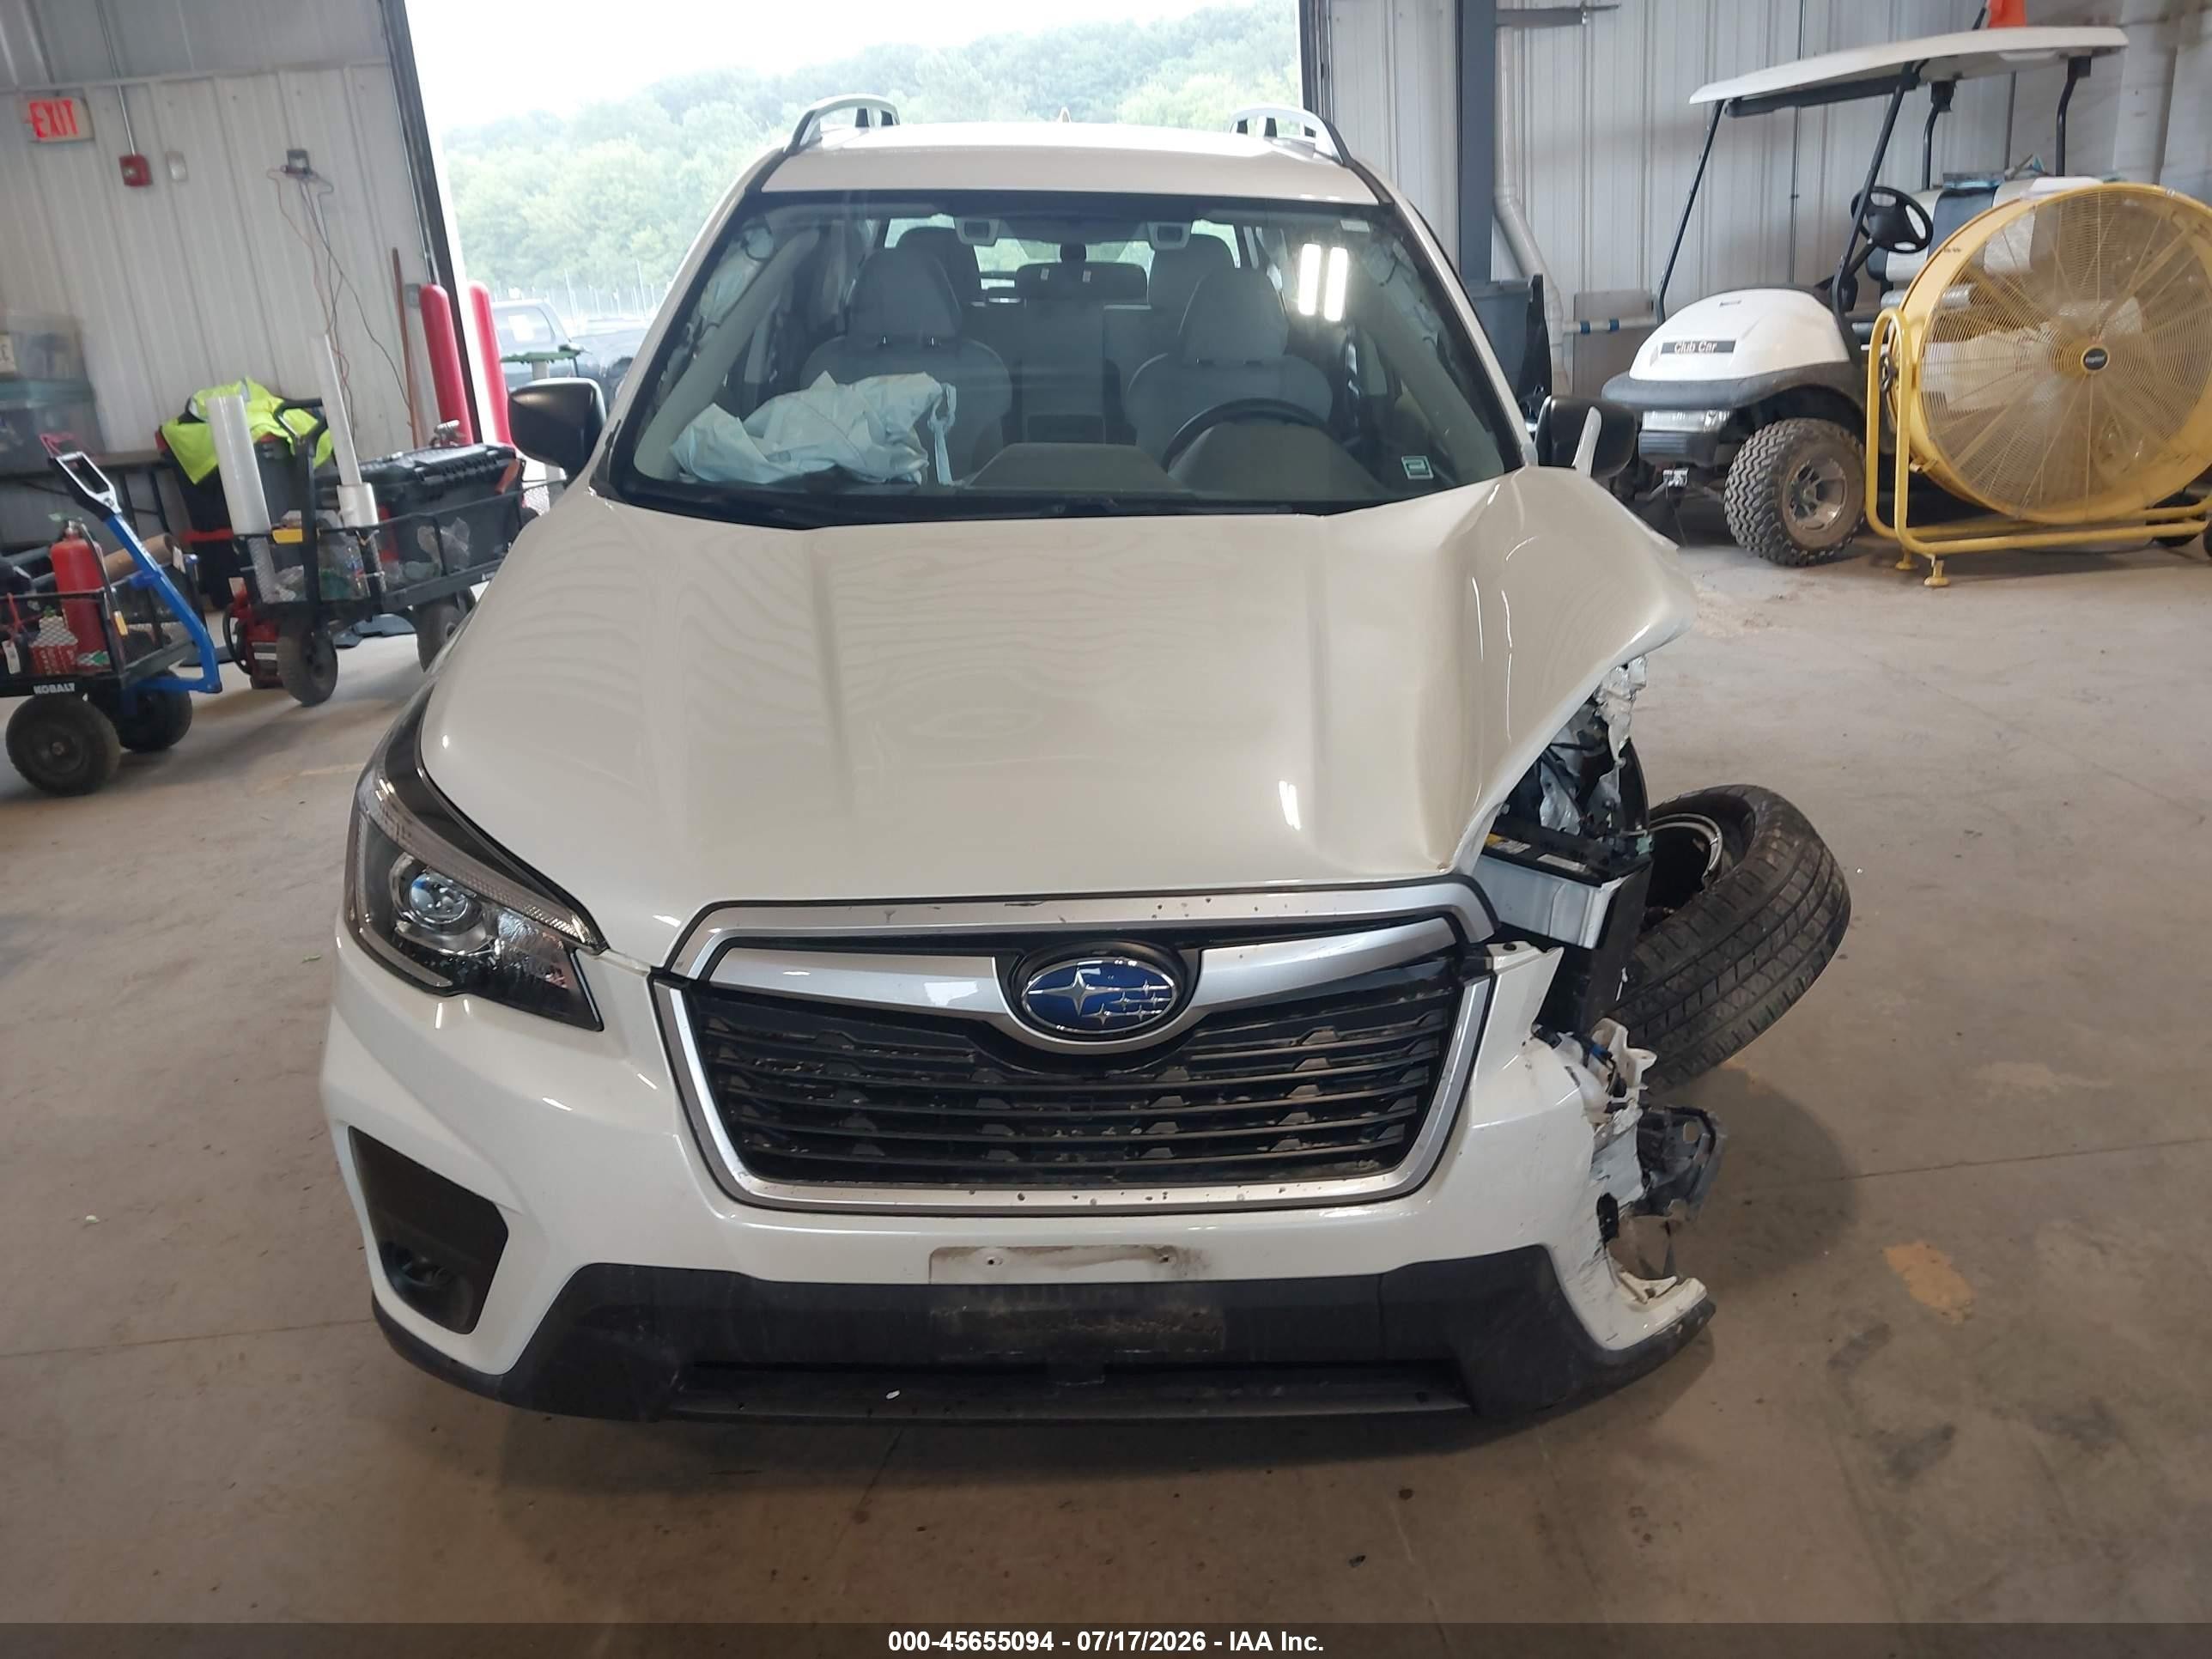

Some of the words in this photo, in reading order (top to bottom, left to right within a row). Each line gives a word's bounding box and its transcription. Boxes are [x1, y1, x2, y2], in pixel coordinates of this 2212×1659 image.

[28, 100, 78, 137] EXIT
[1674, 341, 1696, 354] Club
[1698, 341, 1717, 353] Car
[33, 683, 76, 695] KOBALT
